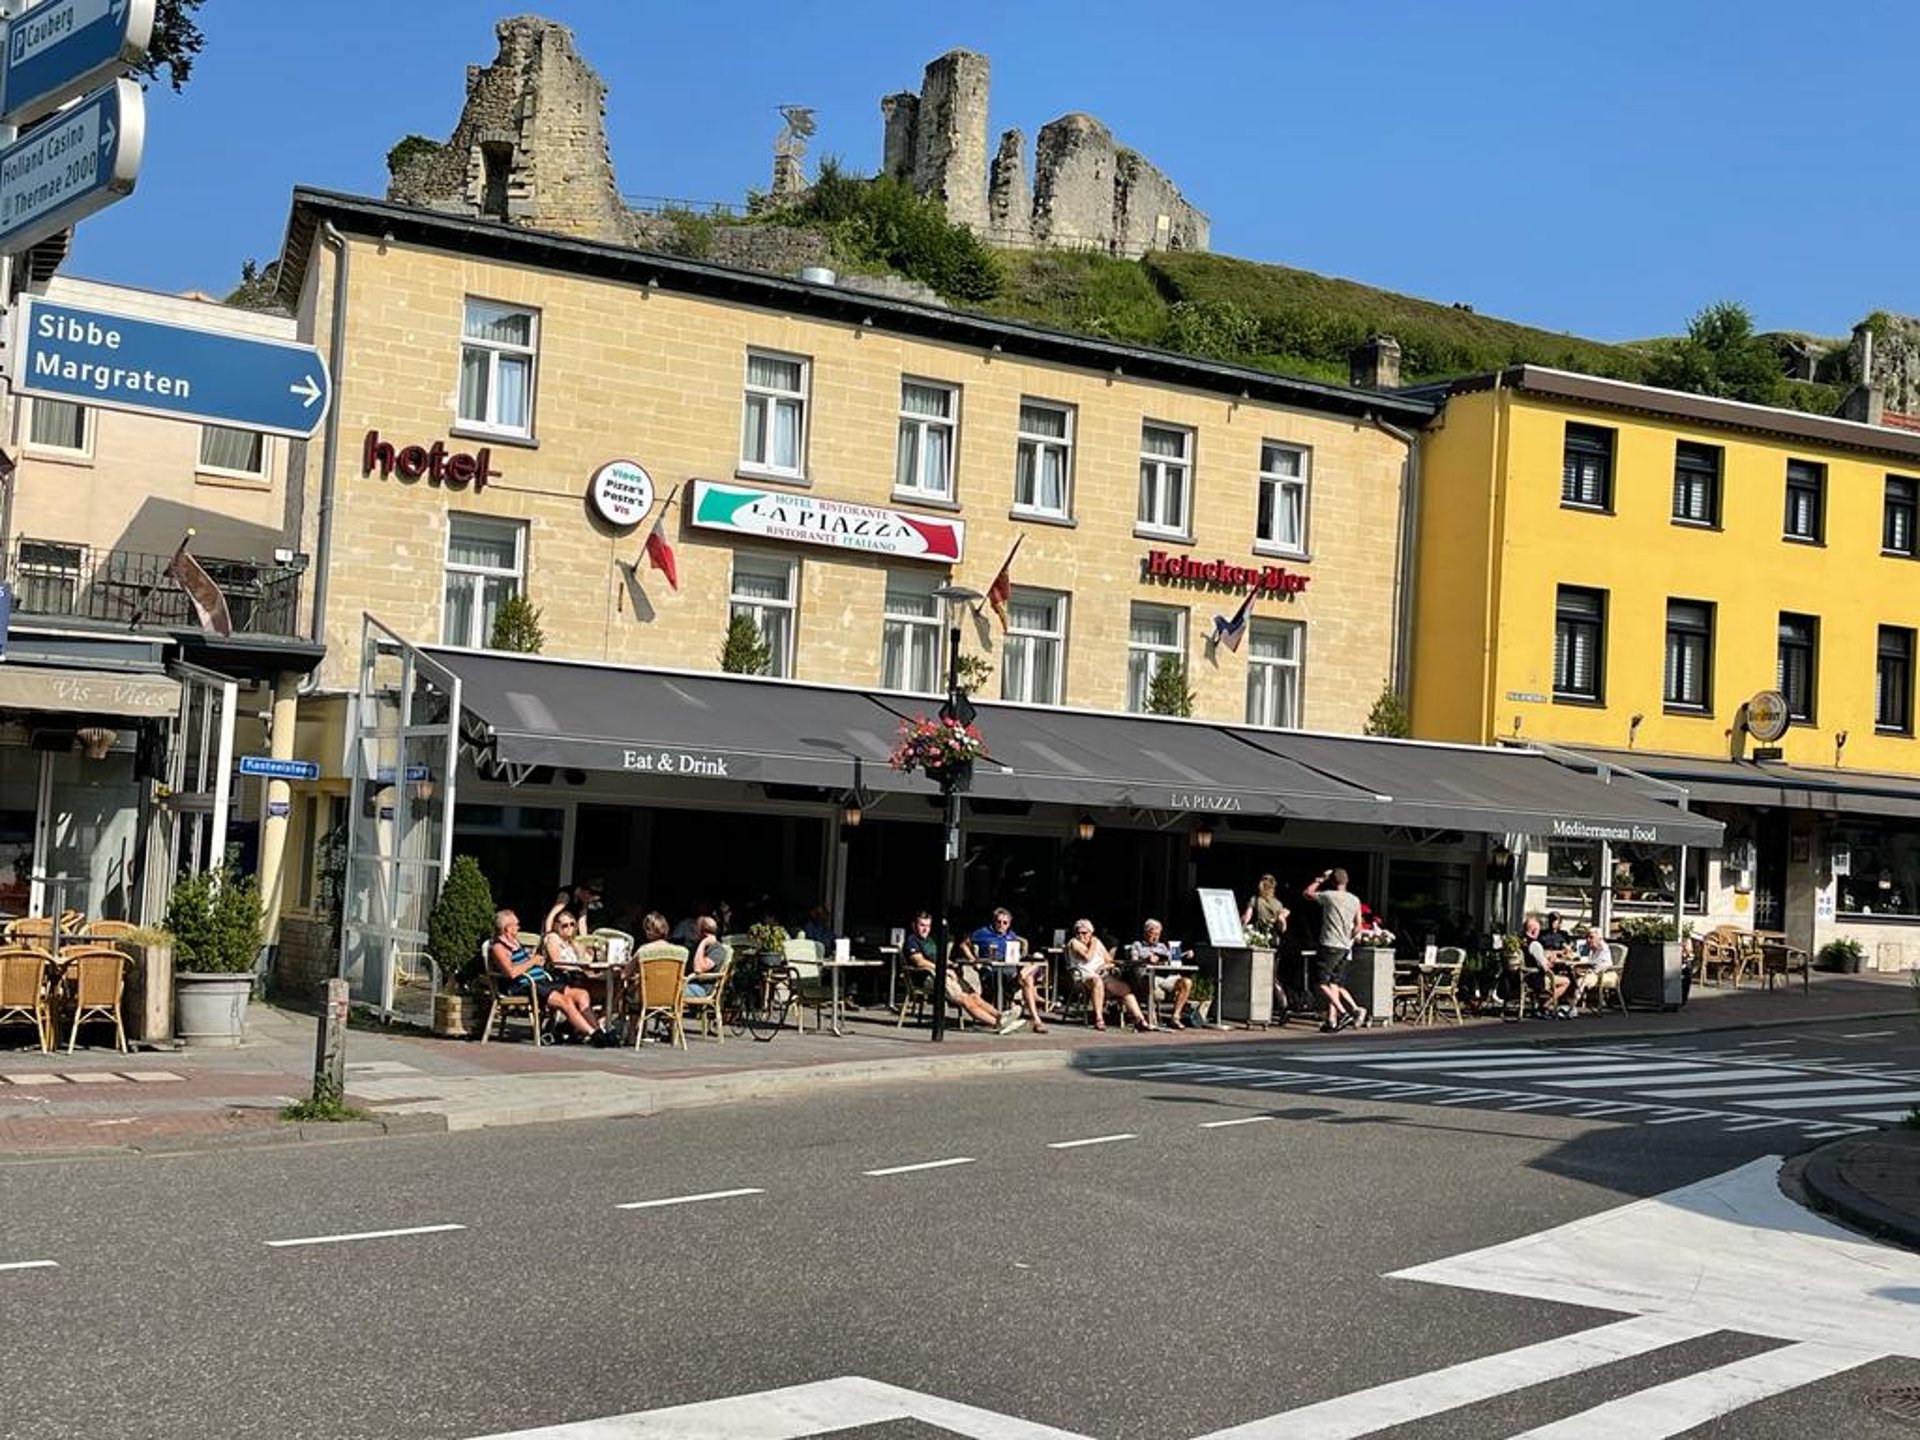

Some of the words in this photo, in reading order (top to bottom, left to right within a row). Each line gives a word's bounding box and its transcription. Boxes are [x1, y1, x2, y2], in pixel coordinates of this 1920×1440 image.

[27, 6, 74, 47] Cauberg
[3, 142, 44, 187] Holland
[47, 124, 84, 160] Casino
[15, 177, 62, 216] Thermae
[65, 151, 96, 188] 2000
[38, 314, 121, 349] Sibbe
[35, 351, 190, 398] Margraten
[362, 430, 491, 490] hotel
[603, 490, 644, 507] Pasta's
[606, 479, 644, 496] Pizza's
[614, 504, 630, 515] Vis
[752, 504, 787, 522] LA
[799, 512, 912, 538] PIAZZA
[775, 495, 812, 509] HOTEL
[818, 502, 889, 520] RISTORANTE
[766, 525, 838, 544] RISTORANTE
[843, 536, 896, 552] ITALIANO
[1148, 550, 1260, 588] Heineken
[623, 750, 653, 770] Eat
[657, 753, 673, 771] &
[679, 754, 728, 776] Drink
[1171, 794, 1190, 808] LA
[1193, 794, 1241, 811] PIAZZA
[1553, 819, 1631, 840] Mediterranean
[1632, 825, 1657, 841] food
